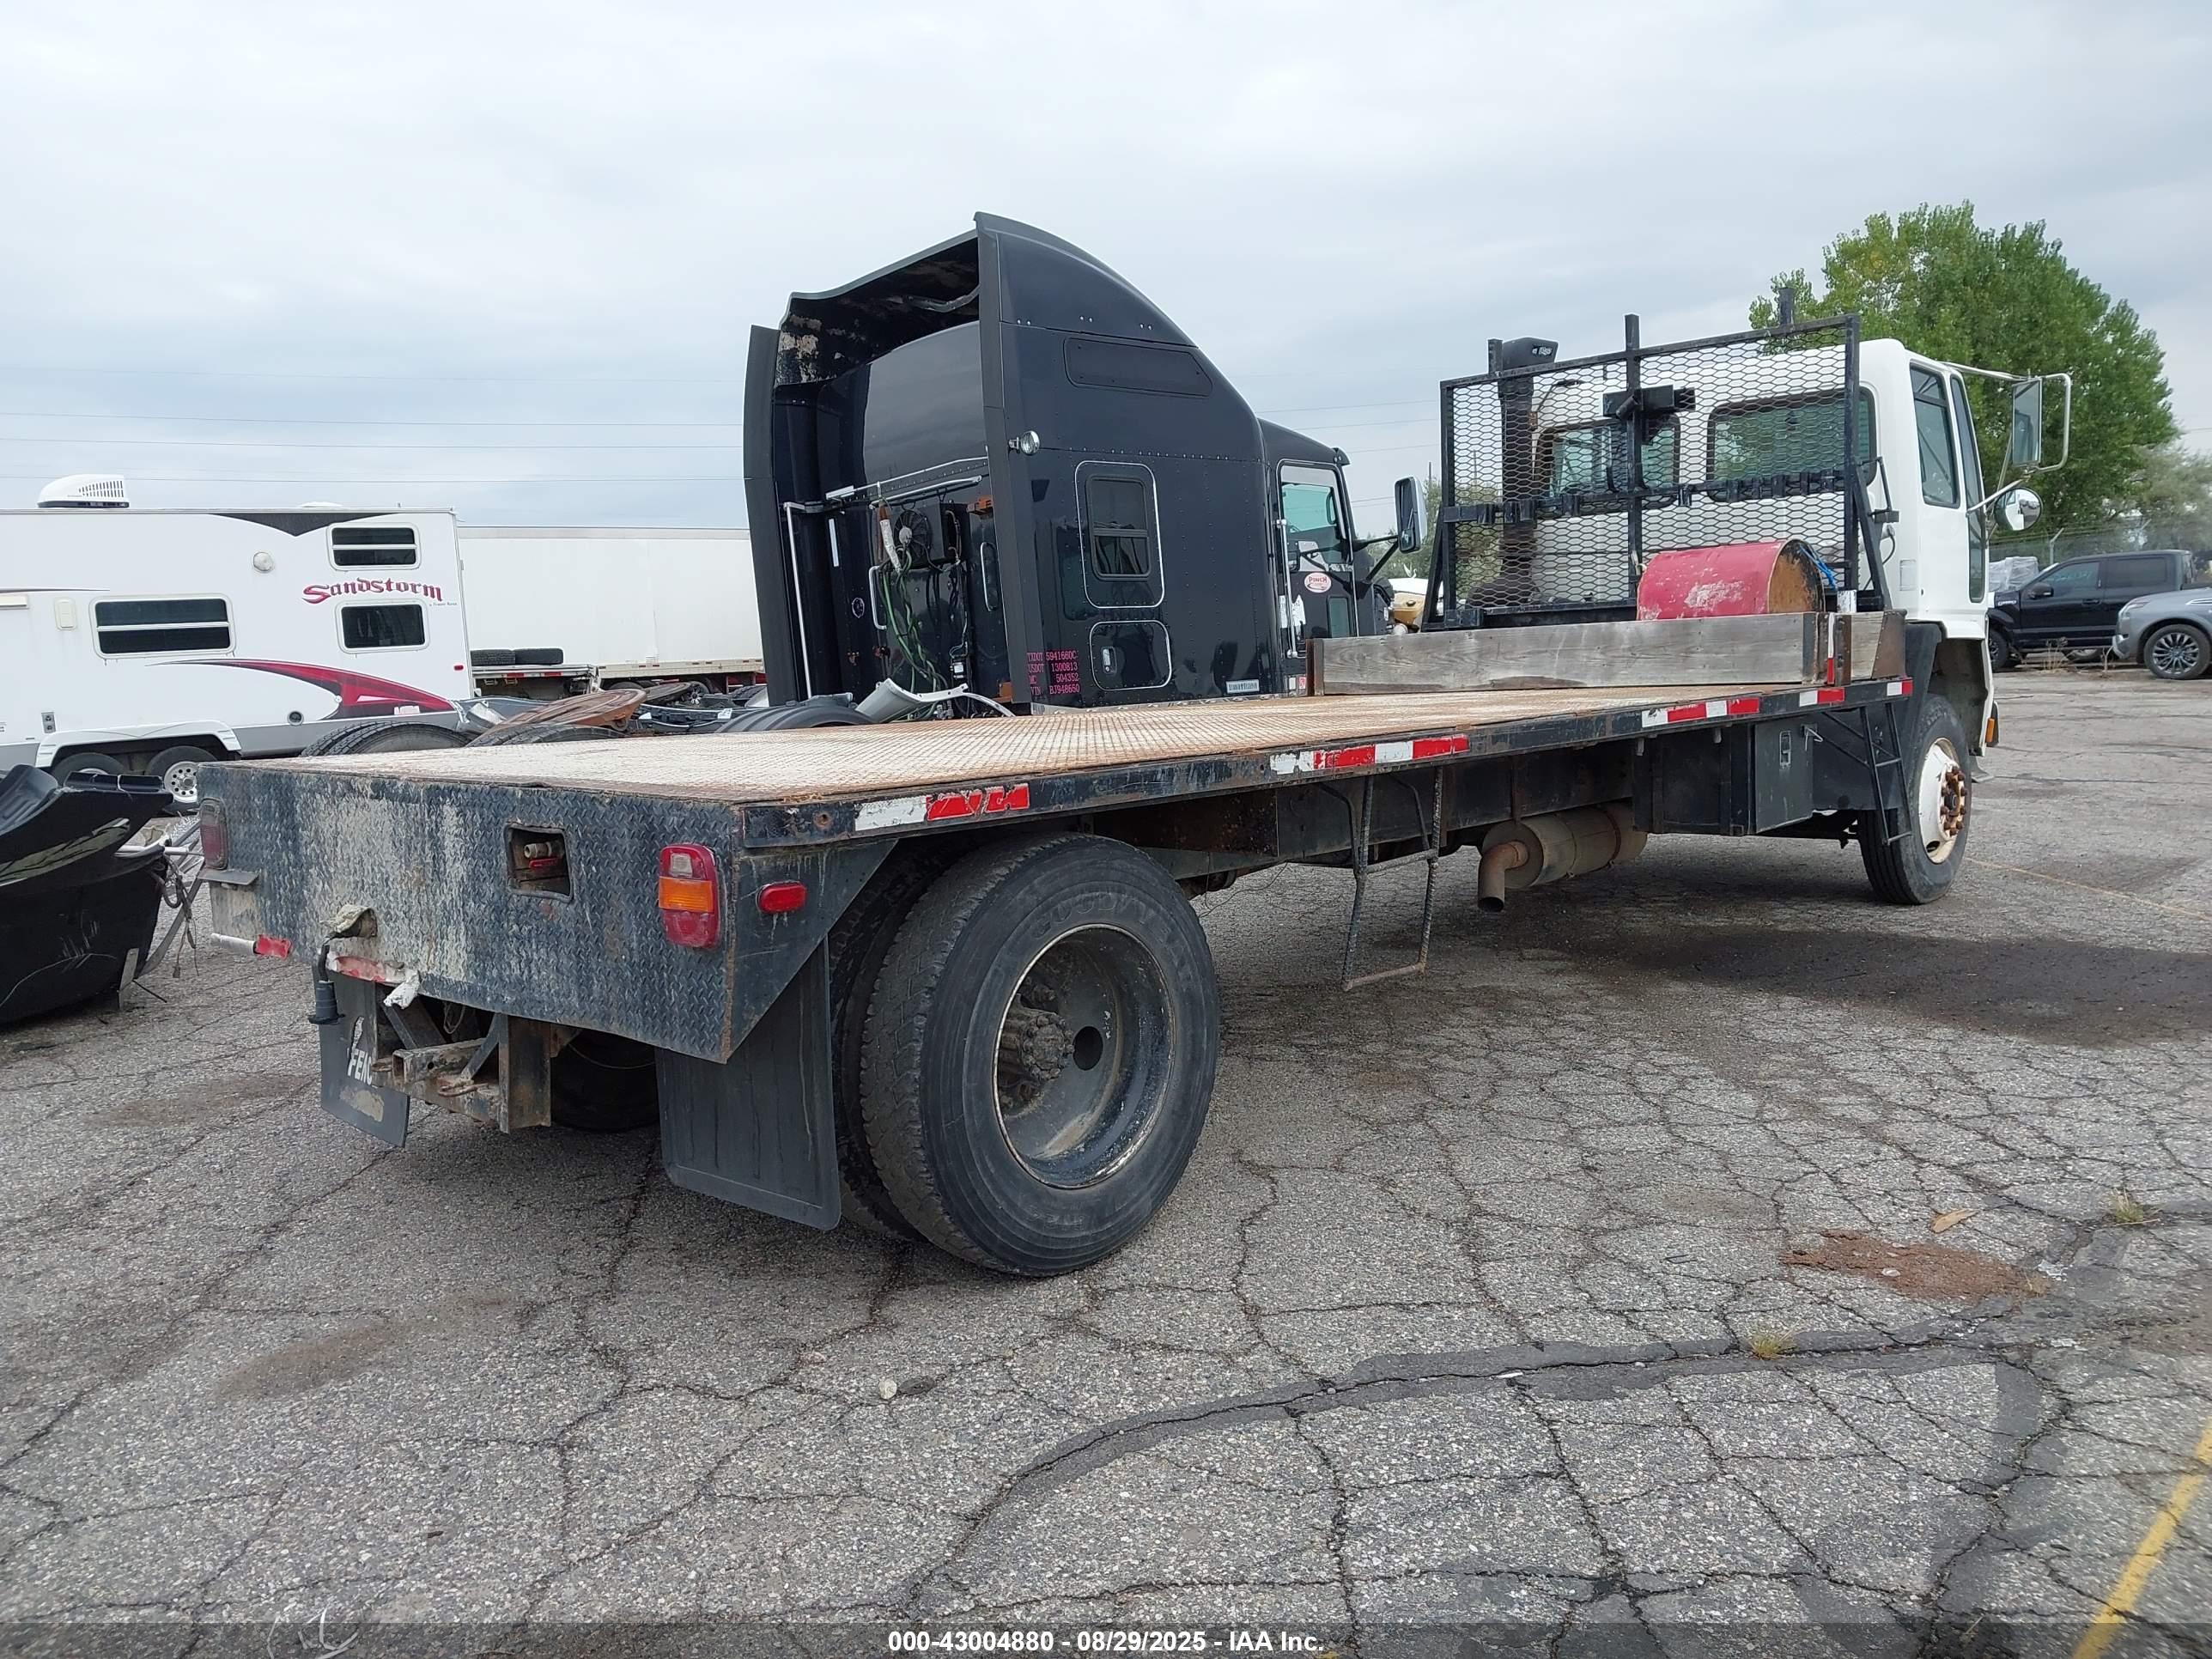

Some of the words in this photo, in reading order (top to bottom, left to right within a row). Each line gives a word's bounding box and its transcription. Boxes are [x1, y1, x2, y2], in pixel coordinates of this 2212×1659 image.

[301, 577, 443, 604] Sandstorm
[1028, 663, 1044, 672] USDOT
[1051, 662, 1078, 672] 1300813
[1030, 686, 1042, 696] VIN
